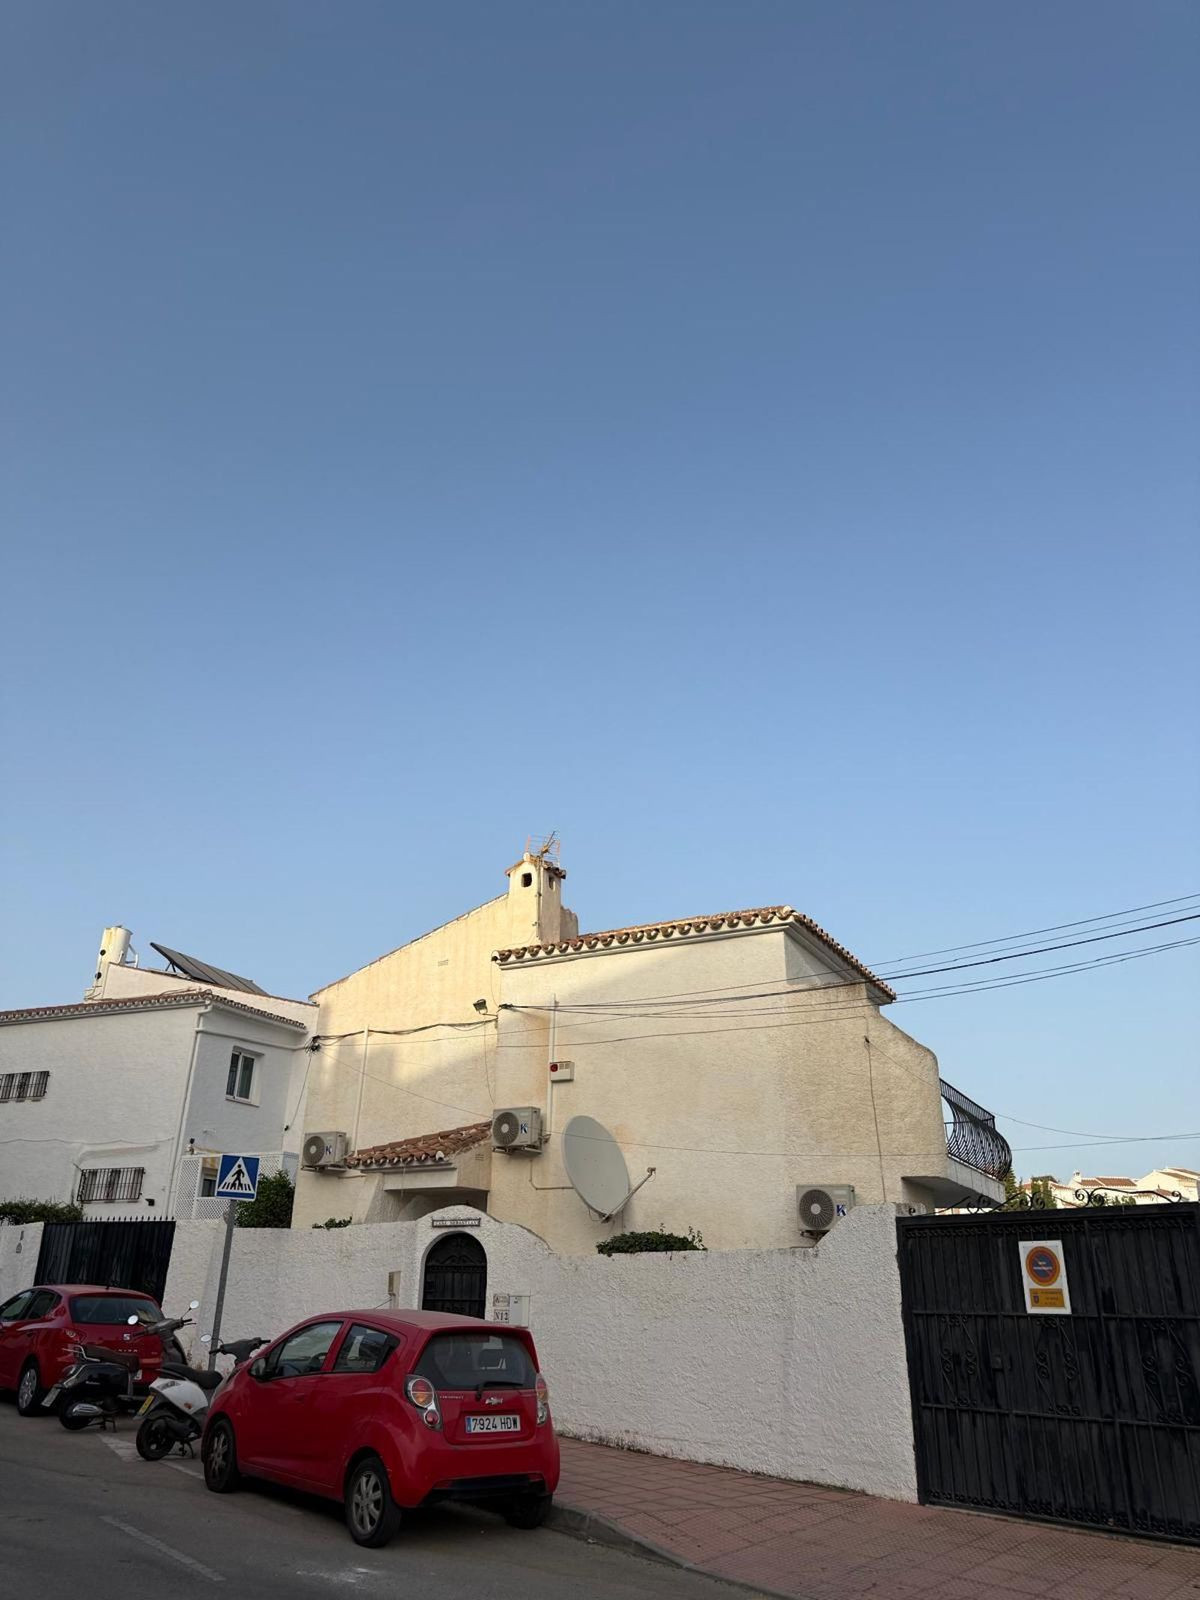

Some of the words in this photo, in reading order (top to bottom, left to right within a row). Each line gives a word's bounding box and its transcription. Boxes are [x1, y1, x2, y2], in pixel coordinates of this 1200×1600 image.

[836, 1204, 846, 1216] K
[472, 1417, 497, 1431] 7924
[500, 1416, 518, 1430] HDW
